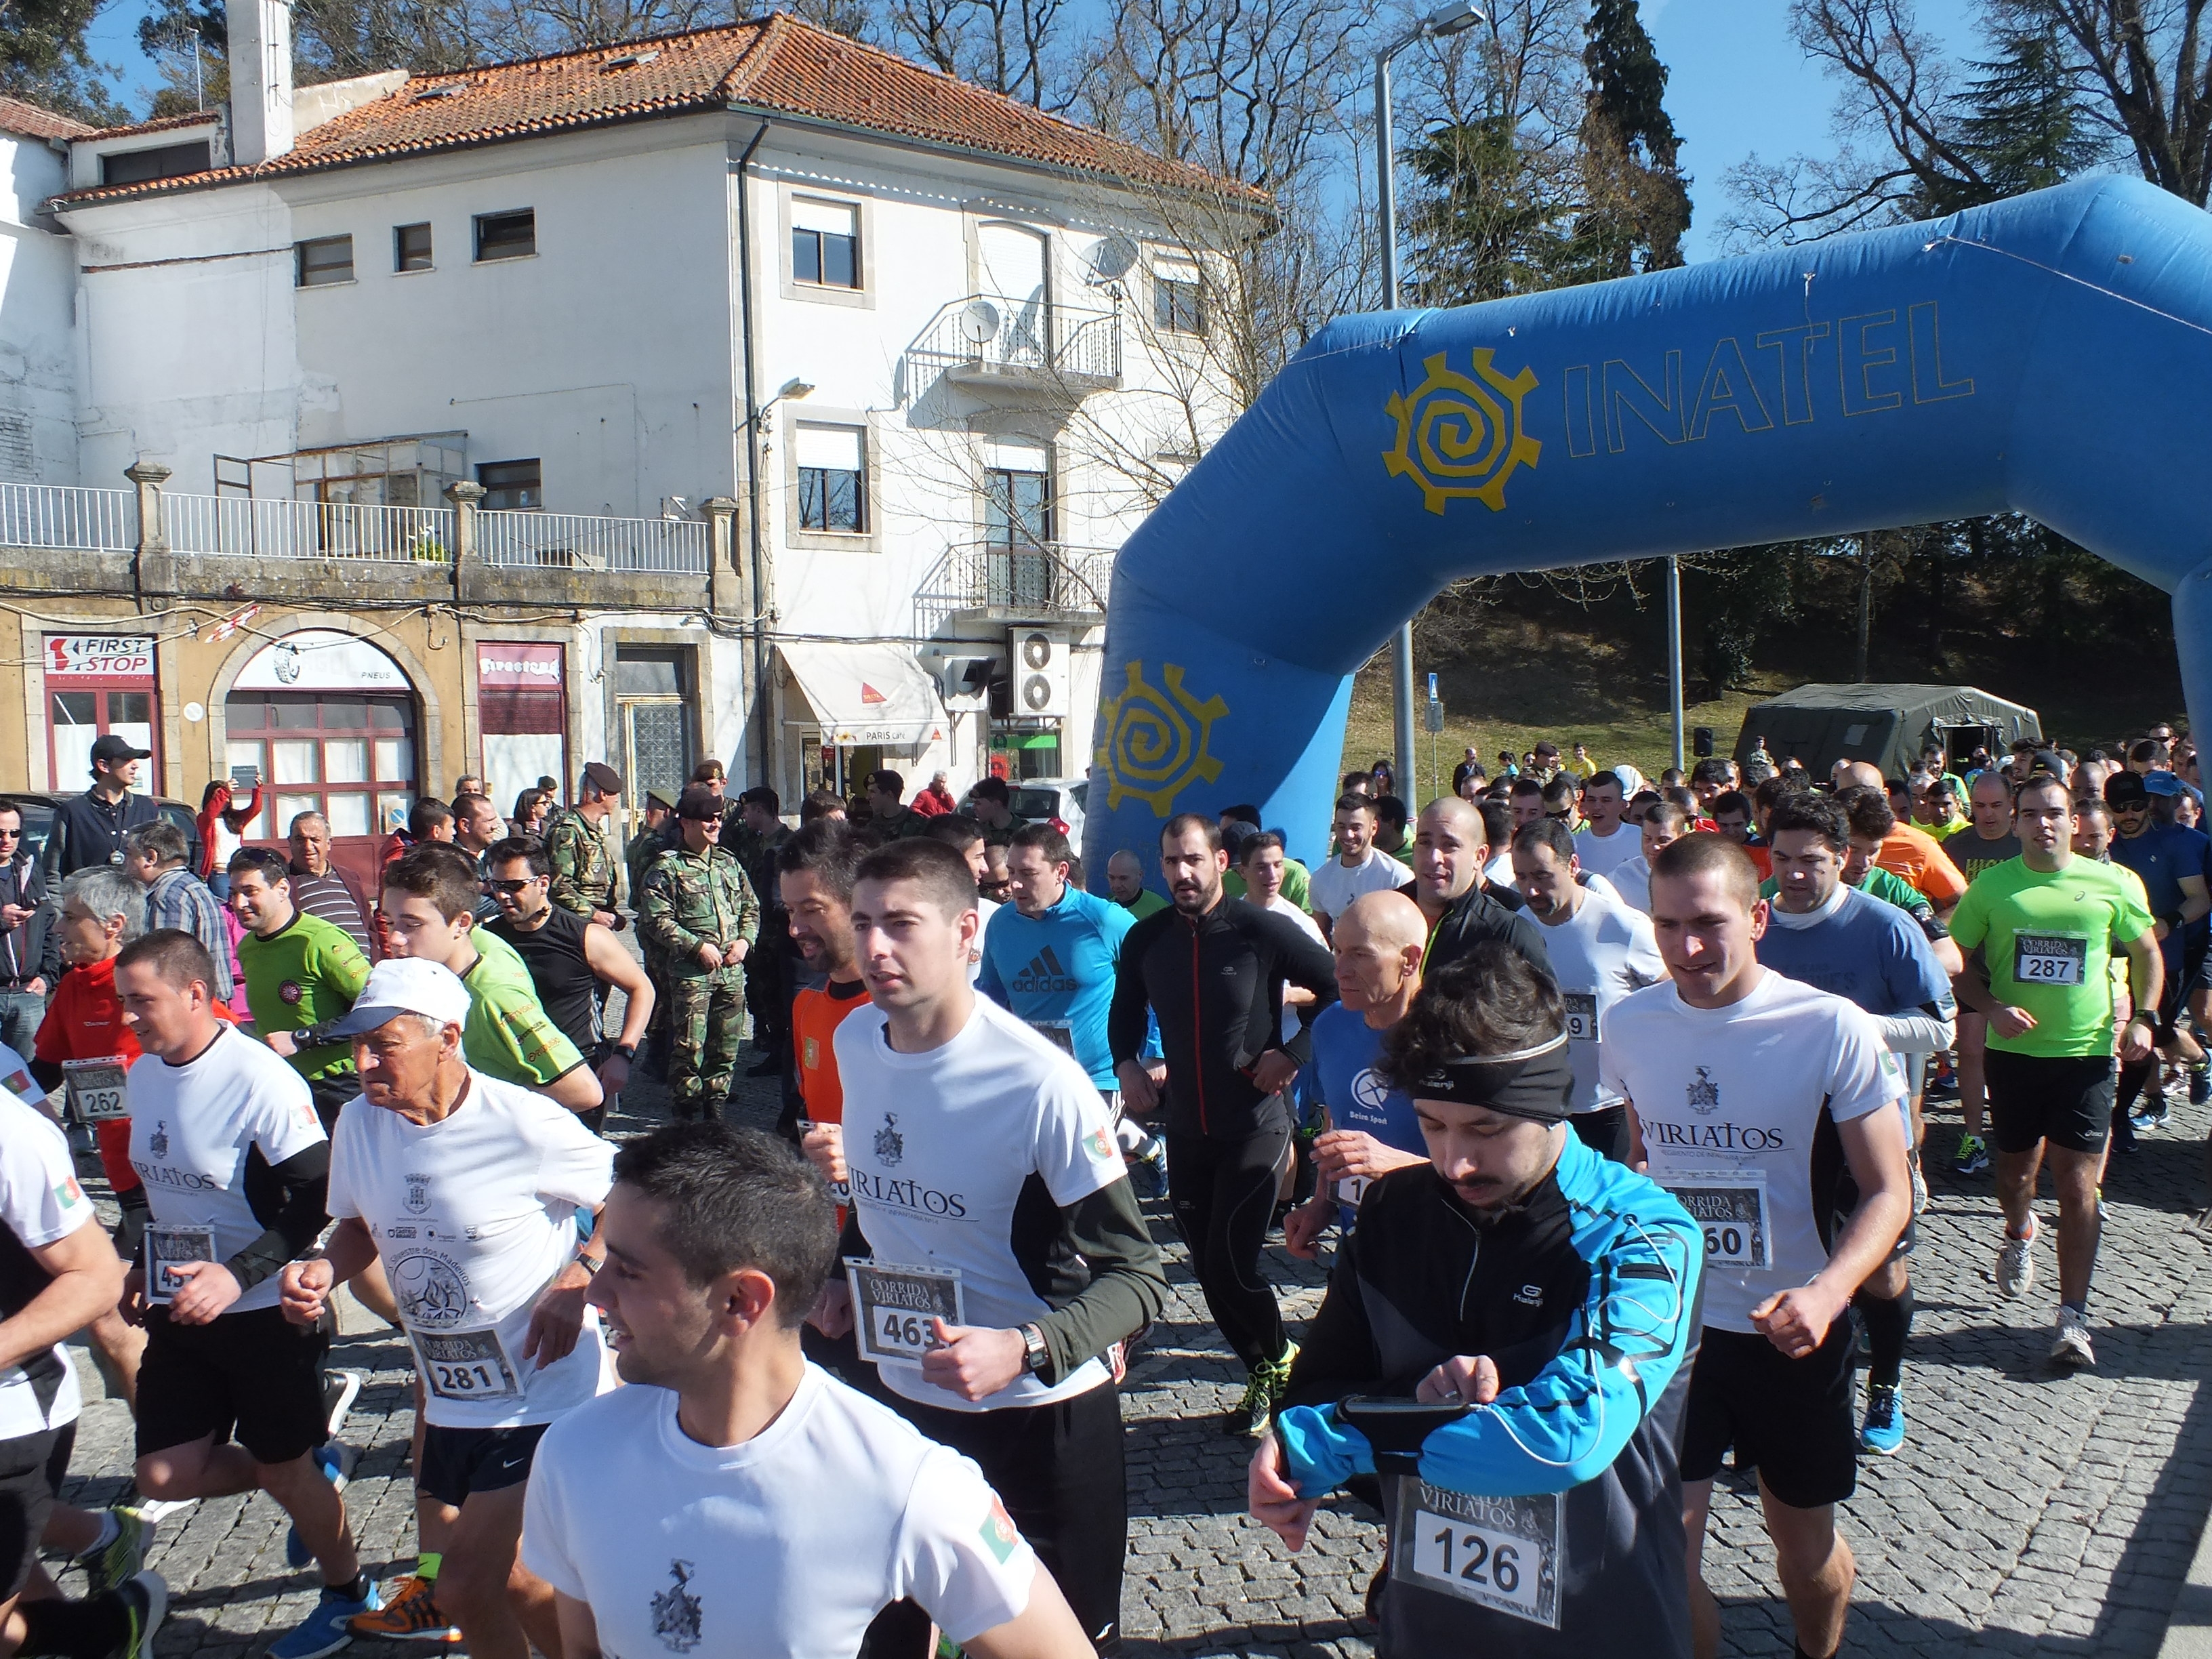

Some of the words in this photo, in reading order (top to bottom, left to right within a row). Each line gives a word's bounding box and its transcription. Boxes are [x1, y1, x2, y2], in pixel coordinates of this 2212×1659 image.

[1563, 300, 1975, 458] INATEL
[85, 638, 146, 653] FIRST
[85, 656, 148, 672] STOP
[866, 731, 890, 740] PARIS
[2022, 939, 2068, 949] CORRIDA
[2023, 945, 2068, 955] VIRIATOS
[2028, 958, 2069, 978] 287
[1012, 976, 1078, 993] adidas
[85, 1091, 123, 1113] 262
[131, 1161, 216, 1189] IRIATOS
[847, 1164, 966, 1218] IRIATOS
[1677, 1195, 1732, 1207] ORRIDA
[422, 1246, 438, 1258] dos
[440, 1251, 472, 1286] Madeiros
[870, 1278, 930, 1298] CORRIDA
[872, 1290, 931, 1309] VIRIATOS
[883, 1314, 942, 1348] 463
[437, 1365, 492, 1389] 281
[1420, 1486, 1516, 1528] VIRIATOS
[1435, 1527, 1519, 1593] 126
